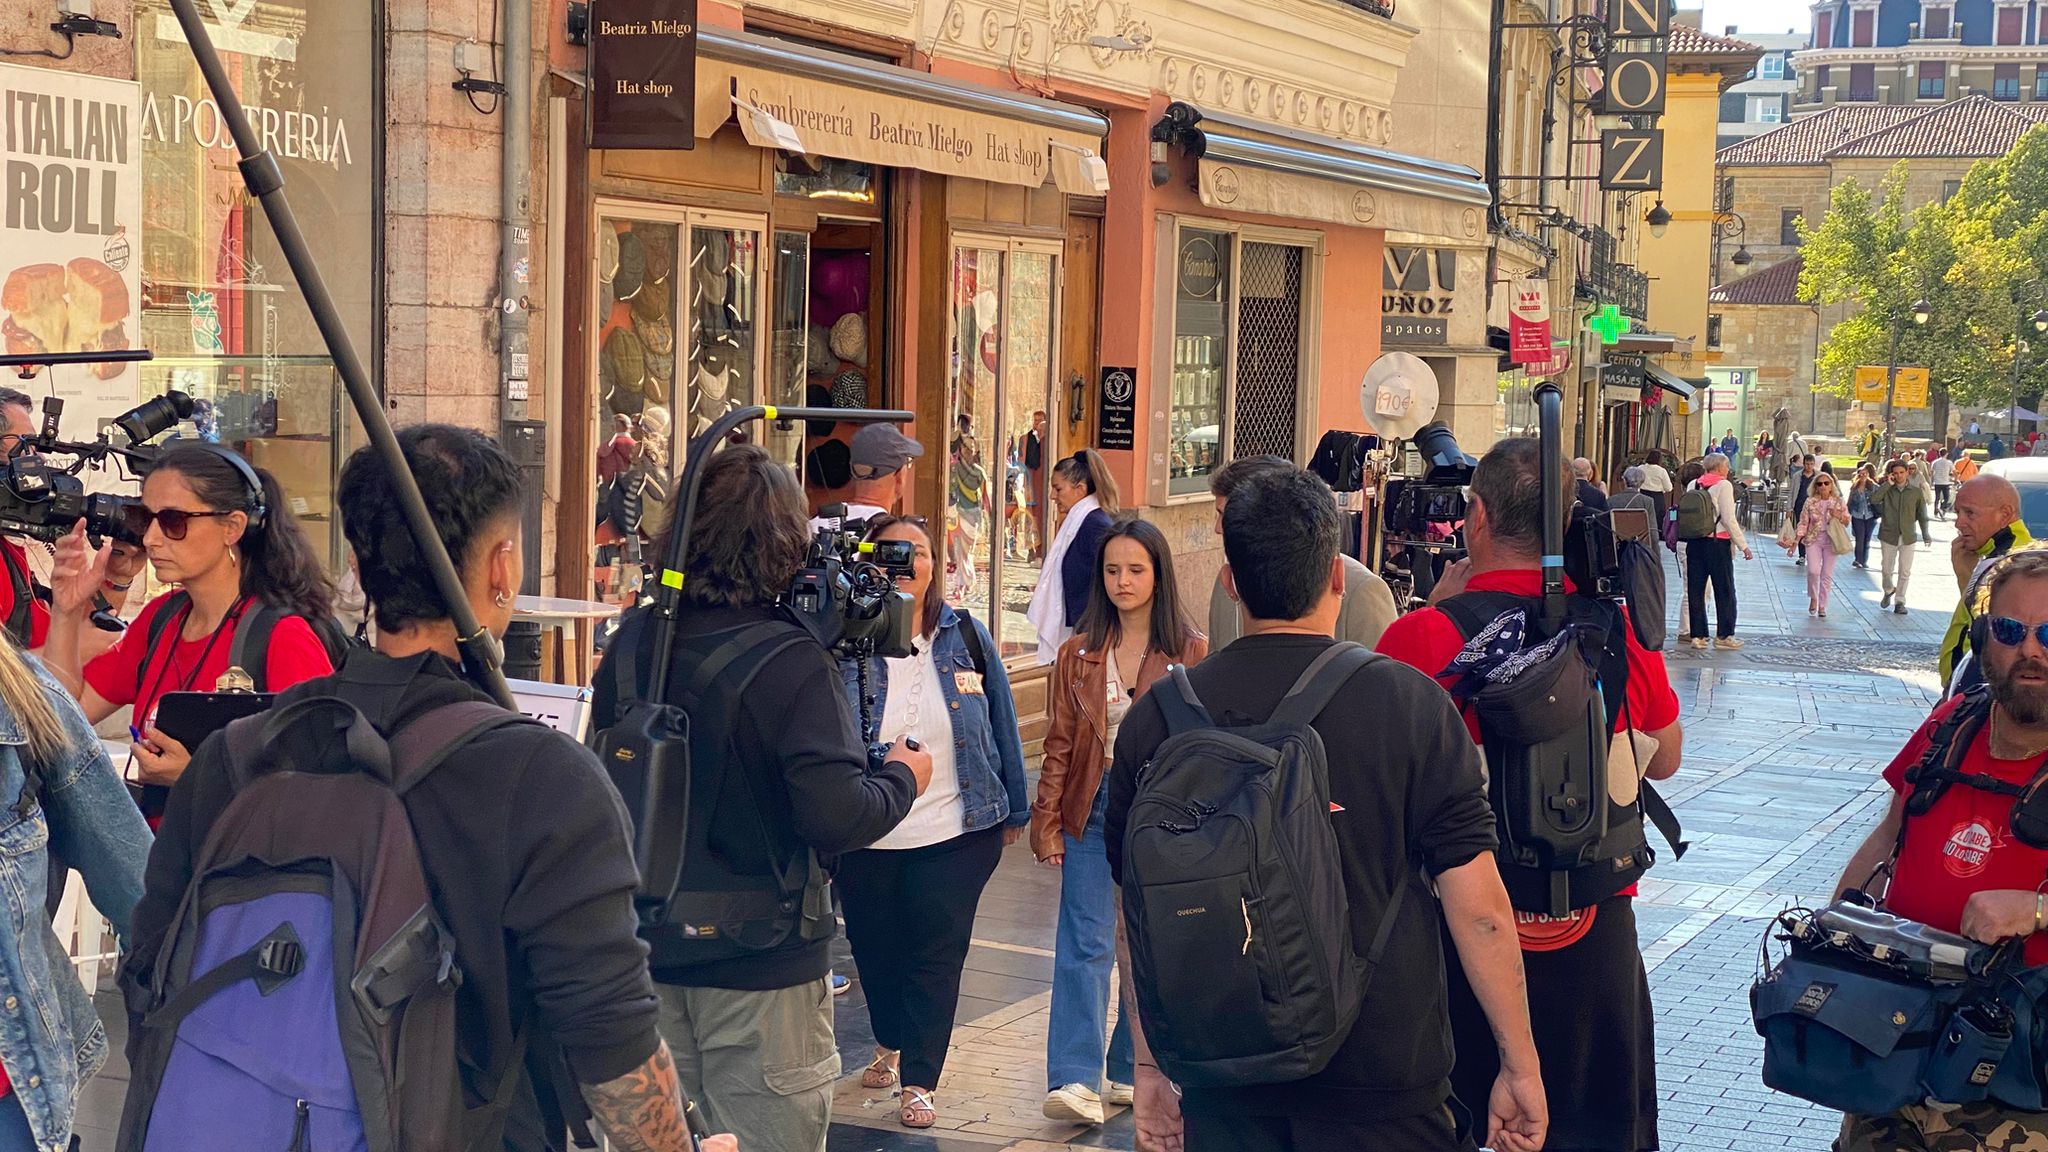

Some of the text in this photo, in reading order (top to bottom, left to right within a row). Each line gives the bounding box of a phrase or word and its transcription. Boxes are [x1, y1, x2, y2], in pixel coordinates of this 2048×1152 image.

[600, 20, 692, 38] Beatriz Mielgo
[616, 80, 673, 98] Hat shop
[6, 89, 127, 165] ITALIAN
[869, 111, 924, 148] Beatriz
[927, 122, 973, 164] Mielgo
[985, 132, 1009, 162] Hat
[1013, 138, 1042, 177] shop
[6, 159, 125, 236] ROLL
[1385, 324, 1441, 336] apatos
[1604, 374, 1641, 386] MASAJES
[1176, 906, 1207, 917] QUECHUA
